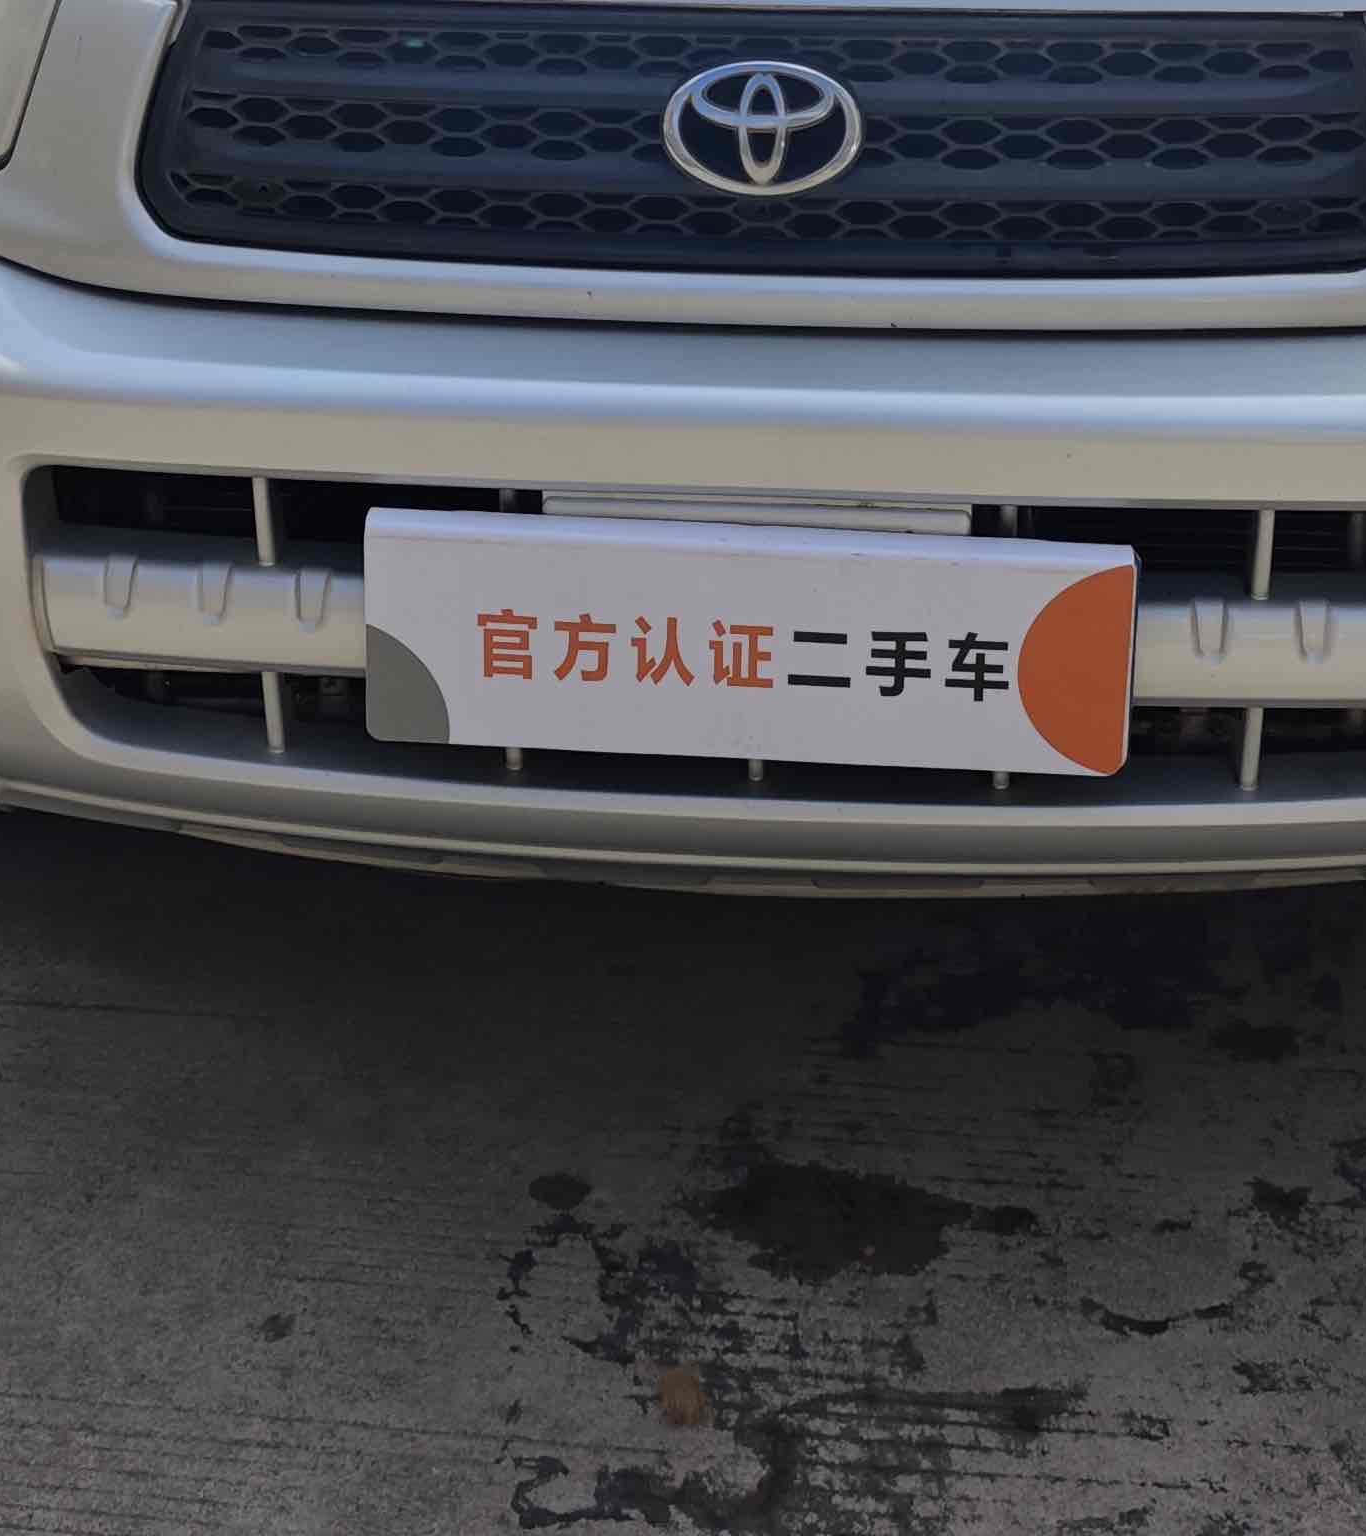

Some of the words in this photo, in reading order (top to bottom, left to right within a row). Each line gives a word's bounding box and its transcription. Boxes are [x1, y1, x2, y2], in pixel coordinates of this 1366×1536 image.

[475, 608, 1011, 702] 官方认证二手车
